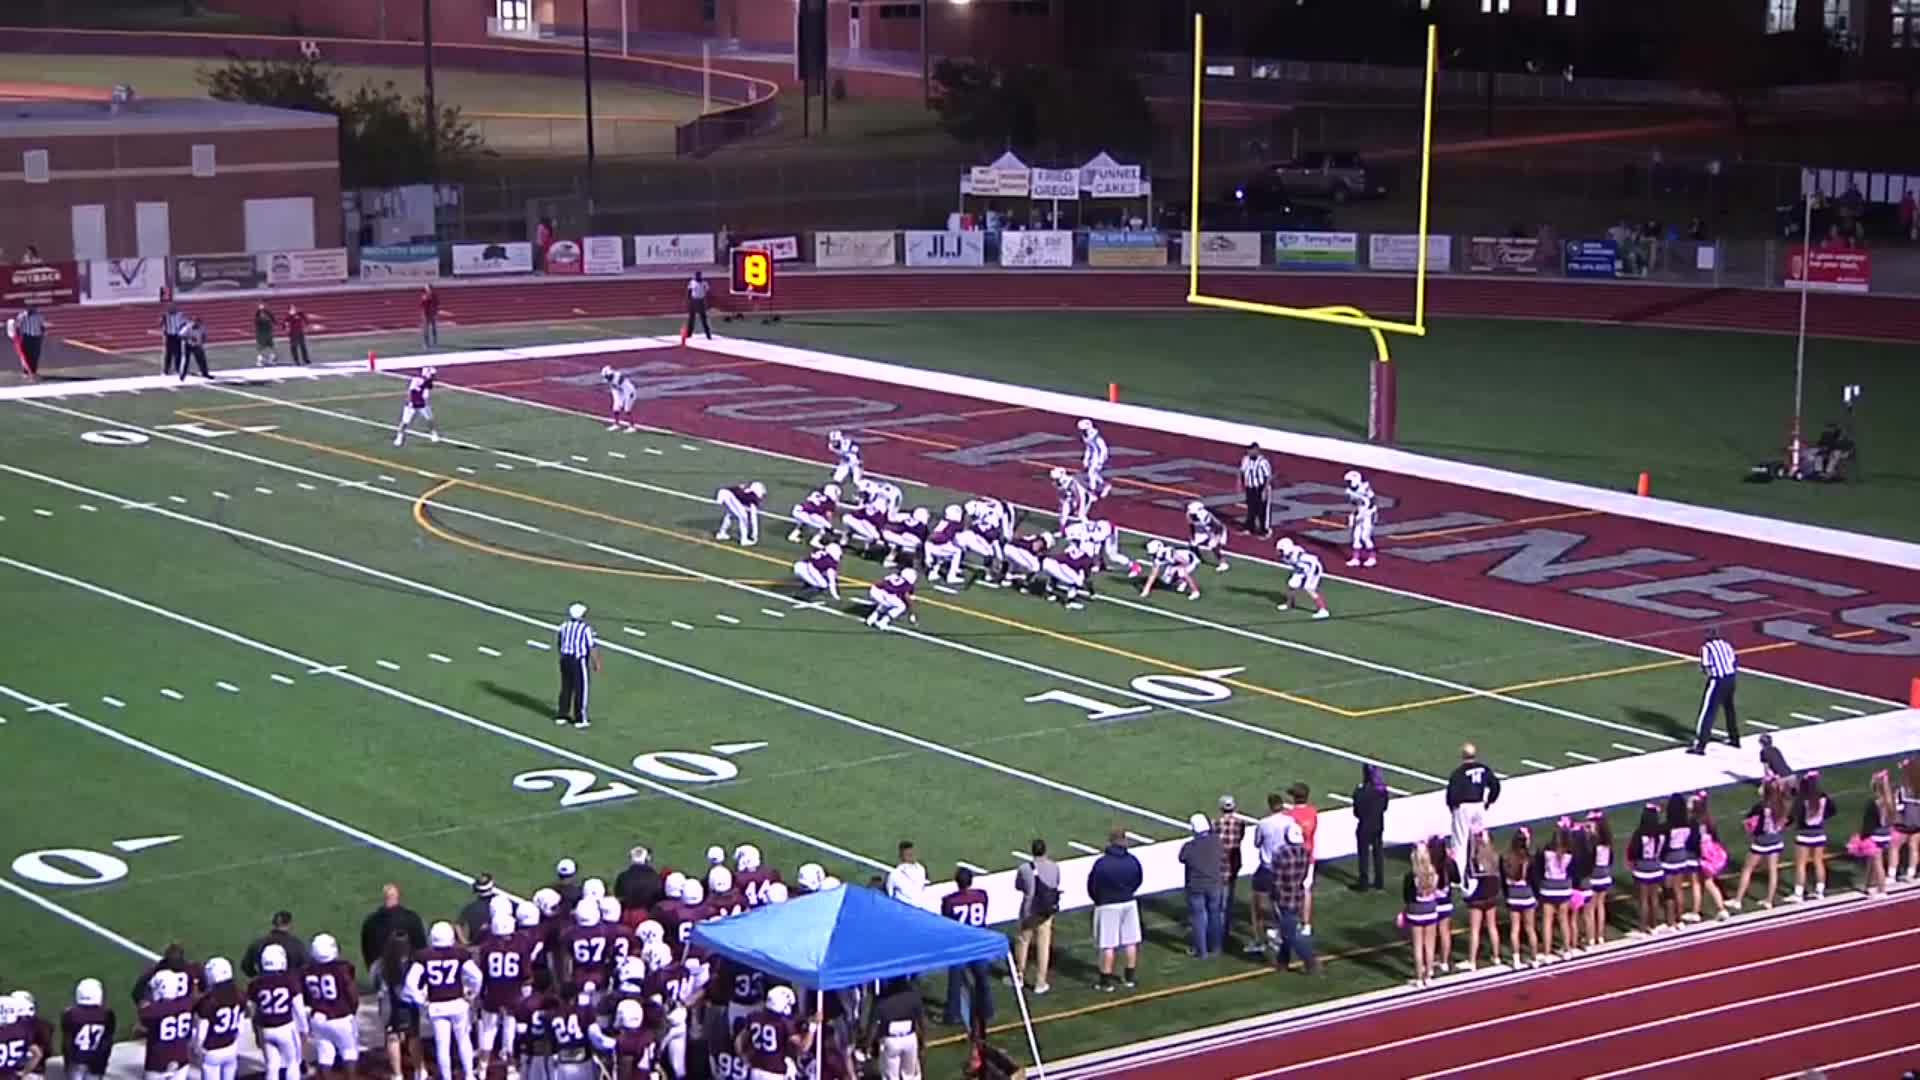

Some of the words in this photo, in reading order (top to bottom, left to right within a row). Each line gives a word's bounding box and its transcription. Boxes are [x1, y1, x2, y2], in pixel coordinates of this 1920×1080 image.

[744, 253, 769, 287] 8
[542, 360, 1920, 656] WOLVERINES
[1024, 672, 1234, 721] 10
[513, 745, 741, 807] 20
[953, 902, 986, 927] 78
[573, 937, 607, 962] 67
[427, 958, 459, 985] 57
[489, 951, 520, 978] 86
[257, 987, 290, 1013] 22
[159, 1012, 193, 1041] 66
[213, 1004, 240, 1033] 31
[551, 1013, 583, 1043] 24
[74, 1023, 105, 1050] 47
[751, 1023, 777, 1052] 29
